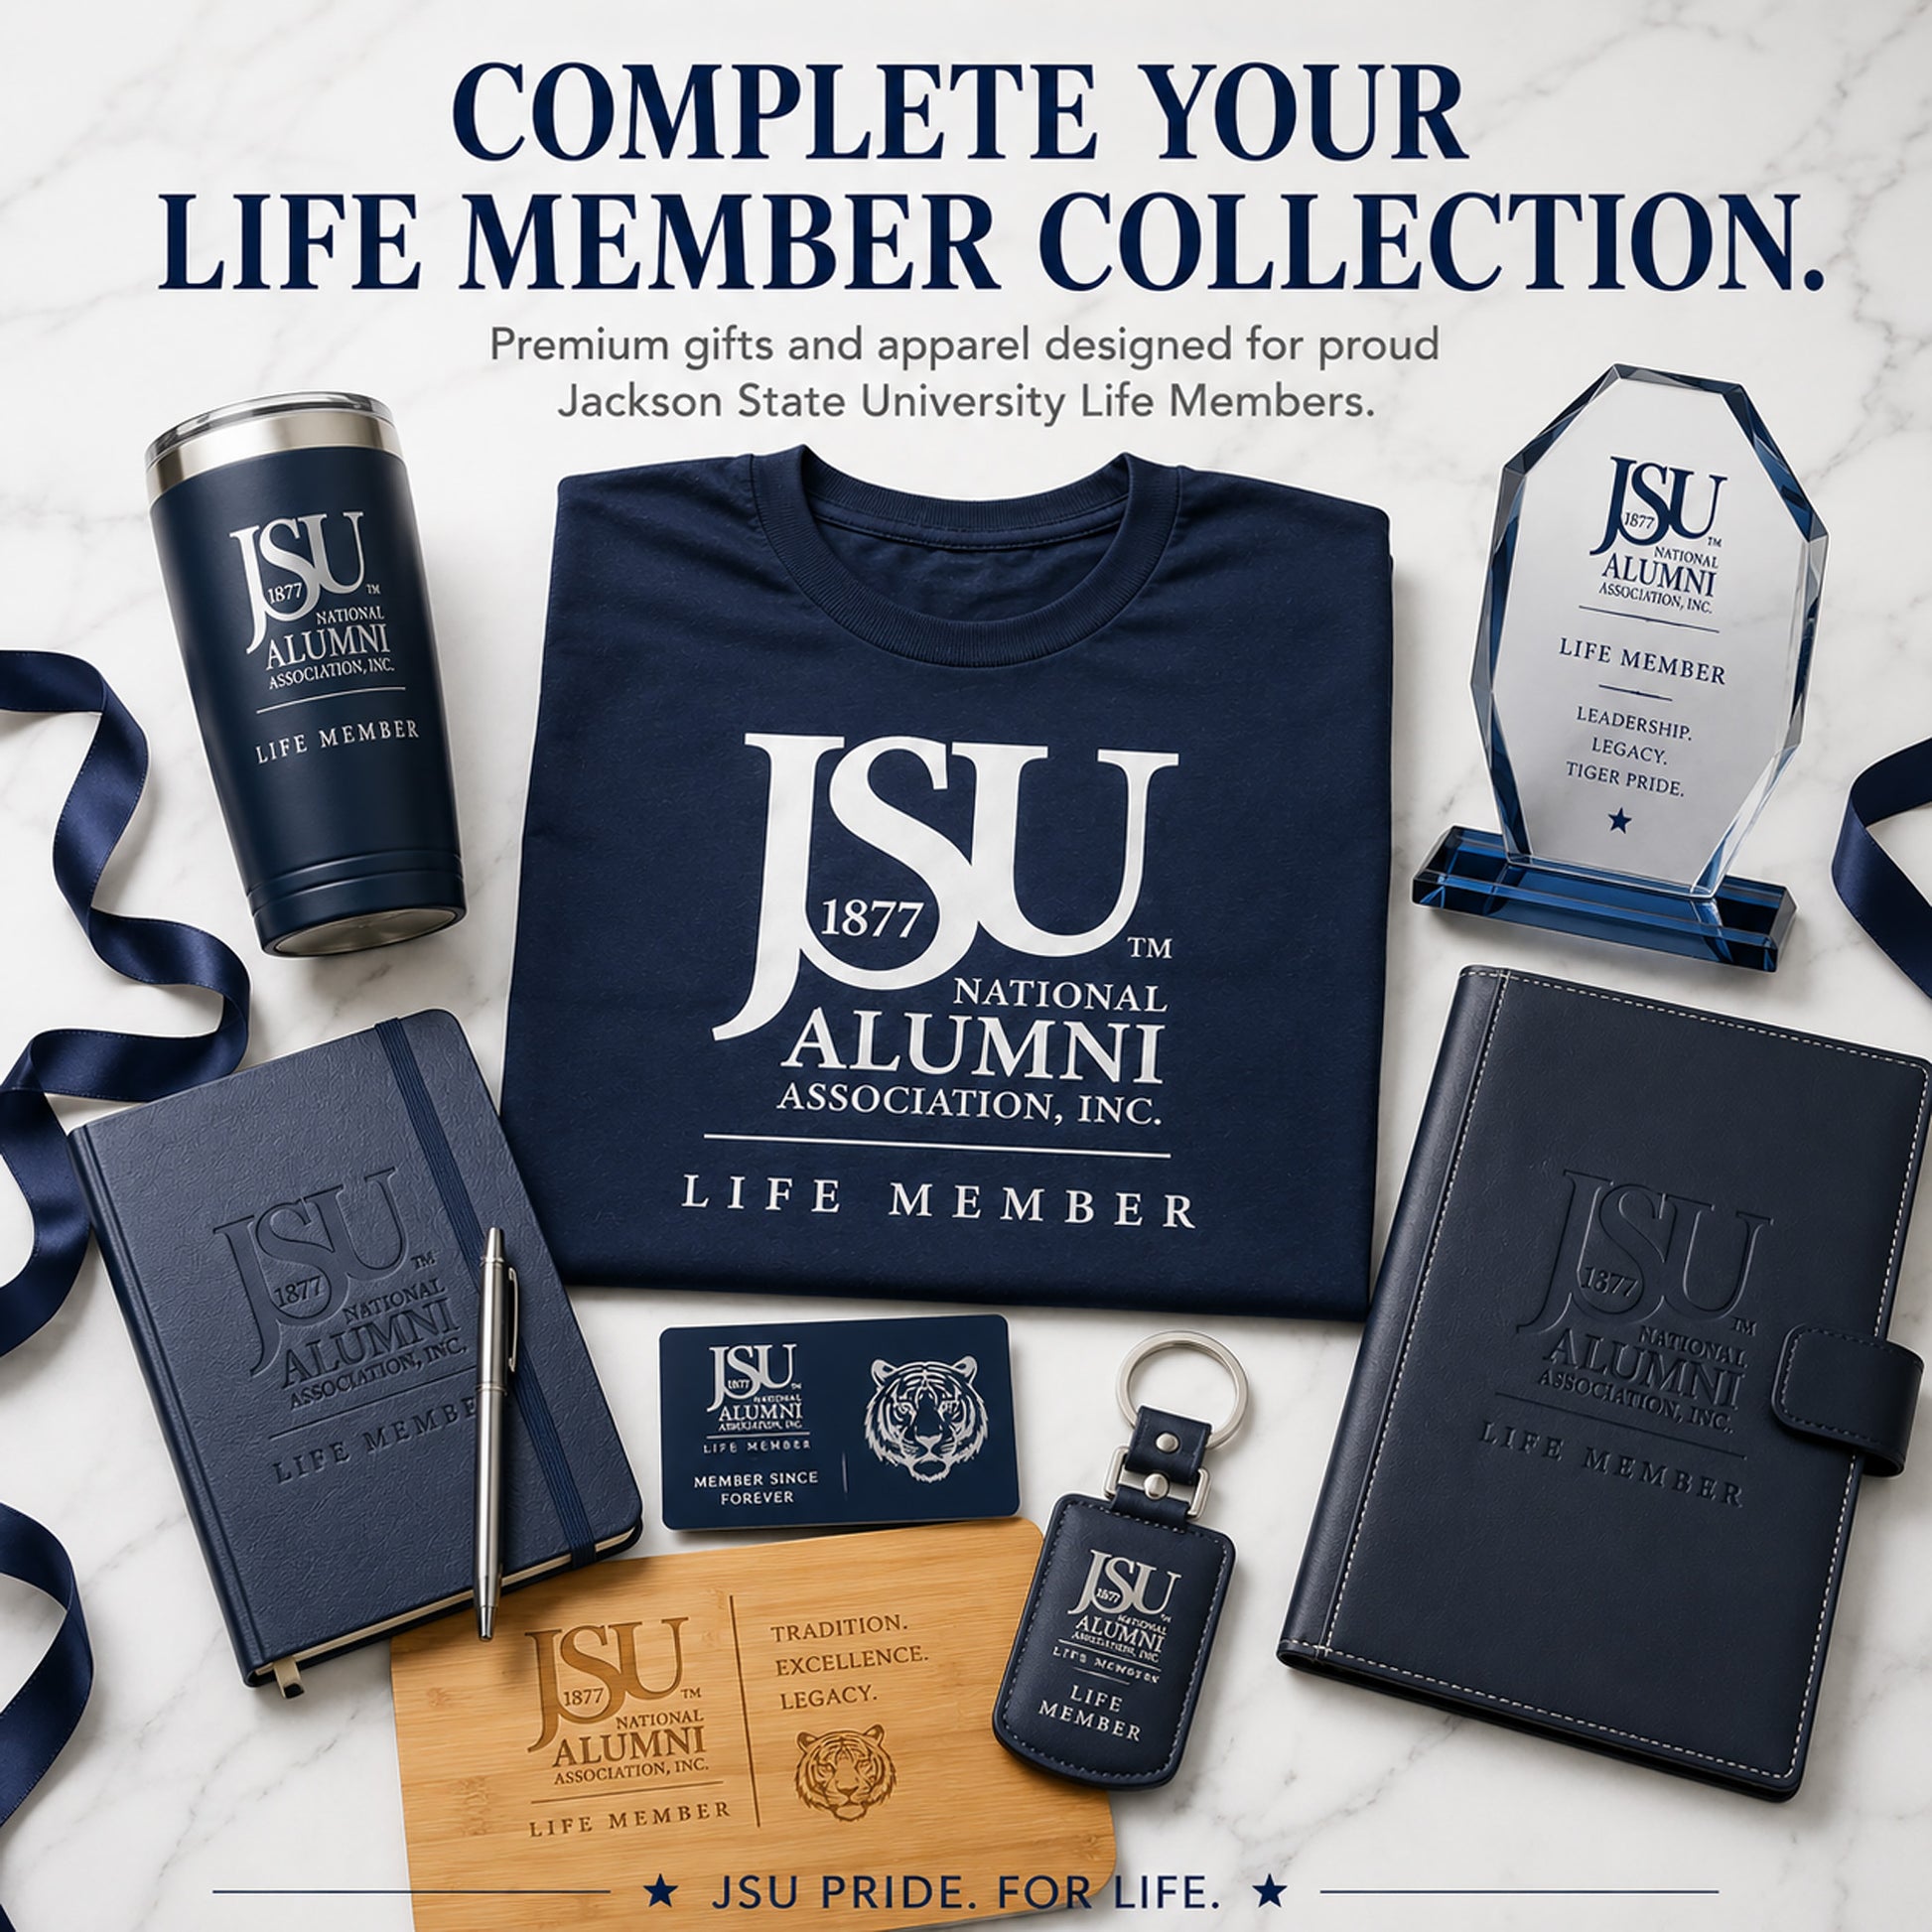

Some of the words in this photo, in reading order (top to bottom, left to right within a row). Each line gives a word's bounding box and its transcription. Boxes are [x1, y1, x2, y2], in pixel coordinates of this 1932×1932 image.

[1589, 456, 1727, 556] JSU
[1623, 512, 1655, 530] 1877
[1601, 552, 1717, 598] ALUMNI
[1654, 546, 1719, 569] NATIONAL
[229, 511, 364, 654] JSU
[268, 583, 302, 604] 1877
[1598, 582, 1685, 611] ASSOCIATION,
[1687, 596, 1713, 615] INC.
[316, 606, 384, 625] NATIONAL
[265, 623, 391, 670] ALUMNI
[1559, 637, 1611, 663] LIFE
[1620, 648, 1726, 685] MEMBER
[268, 660, 367, 689] ASSOCIATION,
[368, 657, 395, 674] INC.
[256, 735, 308, 764] LIFE
[320, 720, 420, 749] MEMBER
[1577, 706, 1692, 741] LEADERSHIP.
[1591, 737, 1667, 764] LEGACY.
[1566, 761, 1619, 785] TIGER
[1625, 772, 1685, 798] PRIDE.
[712, 733, 1179, 1040] JSU
[821, 898, 924, 938] 1877
[953, 977, 1169, 1013] NATIONAL
[780, 1007, 1167, 1084] ALUMNI
[776, 1082, 1064, 1126] ASSOCIATION,
[1077, 1095, 1163, 1126] INC.
[681, 1174, 841, 1213] LIFE
[889, 1181, 1195, 1229] MEMBER
[212, 1167, 408, 1377] JSU
[1516, 1169, 1774, 1334] JSU
[275, 1276, 323, 1309] 1877
[342, 1278, 446, 1323] NATIONAL
[1581, 1266, 1638, 1297] 1877
[281, 1298, 461, 1390] ALUMNI
[1638, 1324, 1748, 1369] NATIONAL
[290, 1351, 422, 1411] ASSOCIATION,
[425, 1337, 468, 1362] INC.
[706, 1343, 797, 1413] JSU
[1543, 1327, 1745, 1411] ALUMNI
[718, 1403, 803, 1422] ALUMNI
[1539, 1368, 1683, 1424] ASSOCIATION,
[1691, 1405, 1734, 1434] INC.
[272, 1442, 349, 1484] LIFE
[362, 1396, 477, 1454] MEMBE
[694, 1474, 763, 1489] MEMBER
[770, 1471, 819, 1485] SINCE
[1478, 1421, 1565, 1461] LIFE
[1582, 1447, 1743, 1508] MEMBER
[721, 1491, 794, 1506] FOREVER
[1067, 1549, 1182, 1615] JSU
[770, 1614, 908, 1643] TRADITION.
[1075, 1615, 1165, 1653] ALUMNI
[775, 1644, 929, 1677] EXCELLENCE.
[524, 1616, 689, 1753] JSU
[563, 1688, 605, 1707] 1877
[780, 1684, 878, 1711] LEGACY.
[1070, 1685, 1123, 1713] LIFE
[616, 1709, 705, 1729] NATIONAL
[1038, 1700, 1141, 1742] MEMBER
[552, 1725, 707, 1768] ALUMNI
[554, 1761, 671, 1786] ASSOCIATION,
[675, 1756, 709, 1773] INC.
[529, 1815, 593, 1838] LIFE
[609, 1801, 731, 1831] MEMBER
